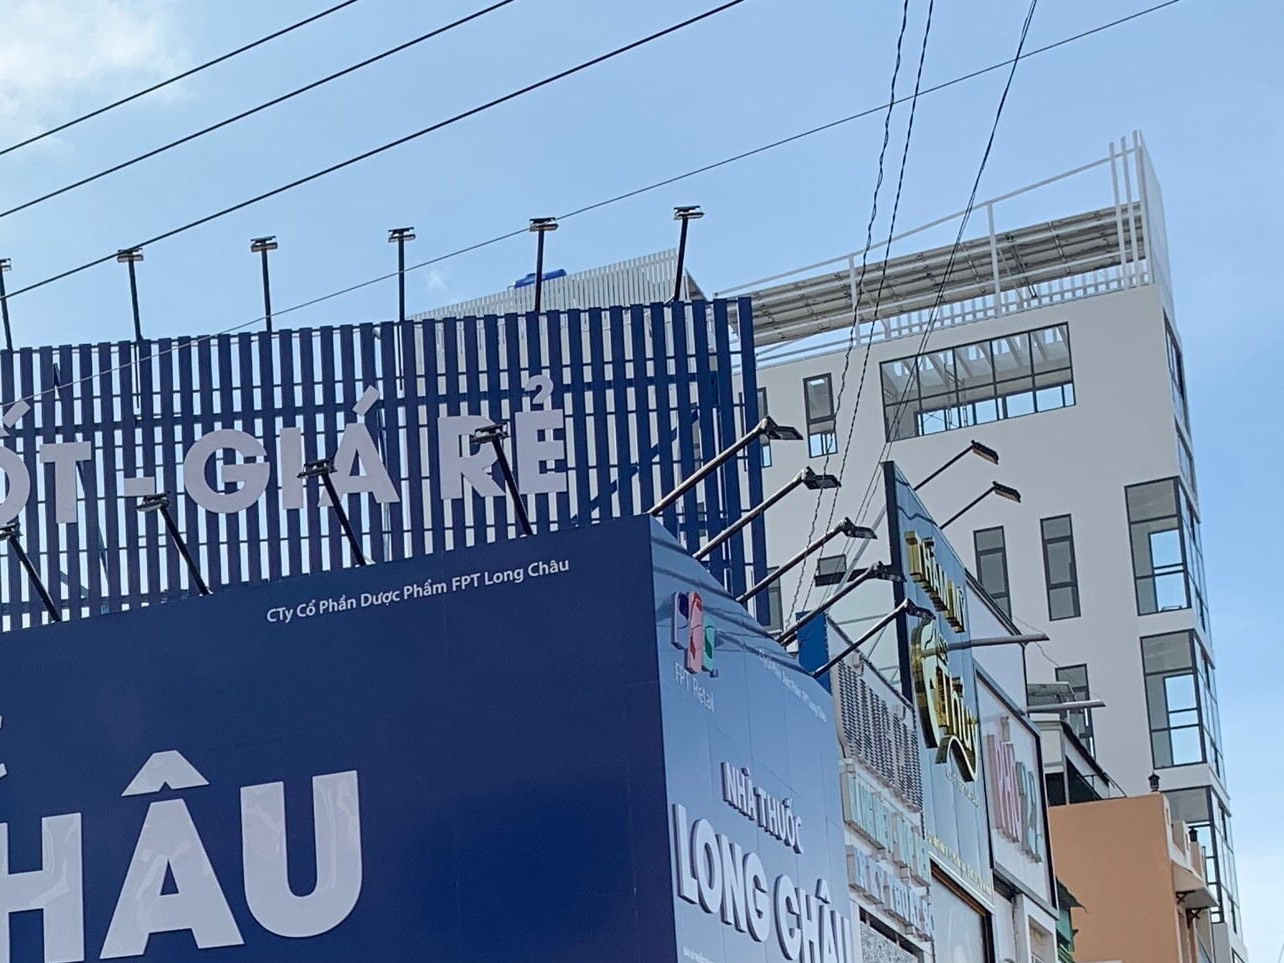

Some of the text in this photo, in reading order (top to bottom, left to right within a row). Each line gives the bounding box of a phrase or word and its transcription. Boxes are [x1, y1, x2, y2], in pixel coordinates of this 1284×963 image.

[183, 385, 400, 514] GIÁ
[438, 374, 567, 500] RẺ
[266, 560, 570, 623] CTy Cổ Phần Dược Phẩm FPT Long Châu
[675, 661, 715, 713] FPT Retail
[721, 760, 757, 821] NHÀ
[754, 787, 804, 854] THUỐC
[672, 802, 771, 943] LONG
